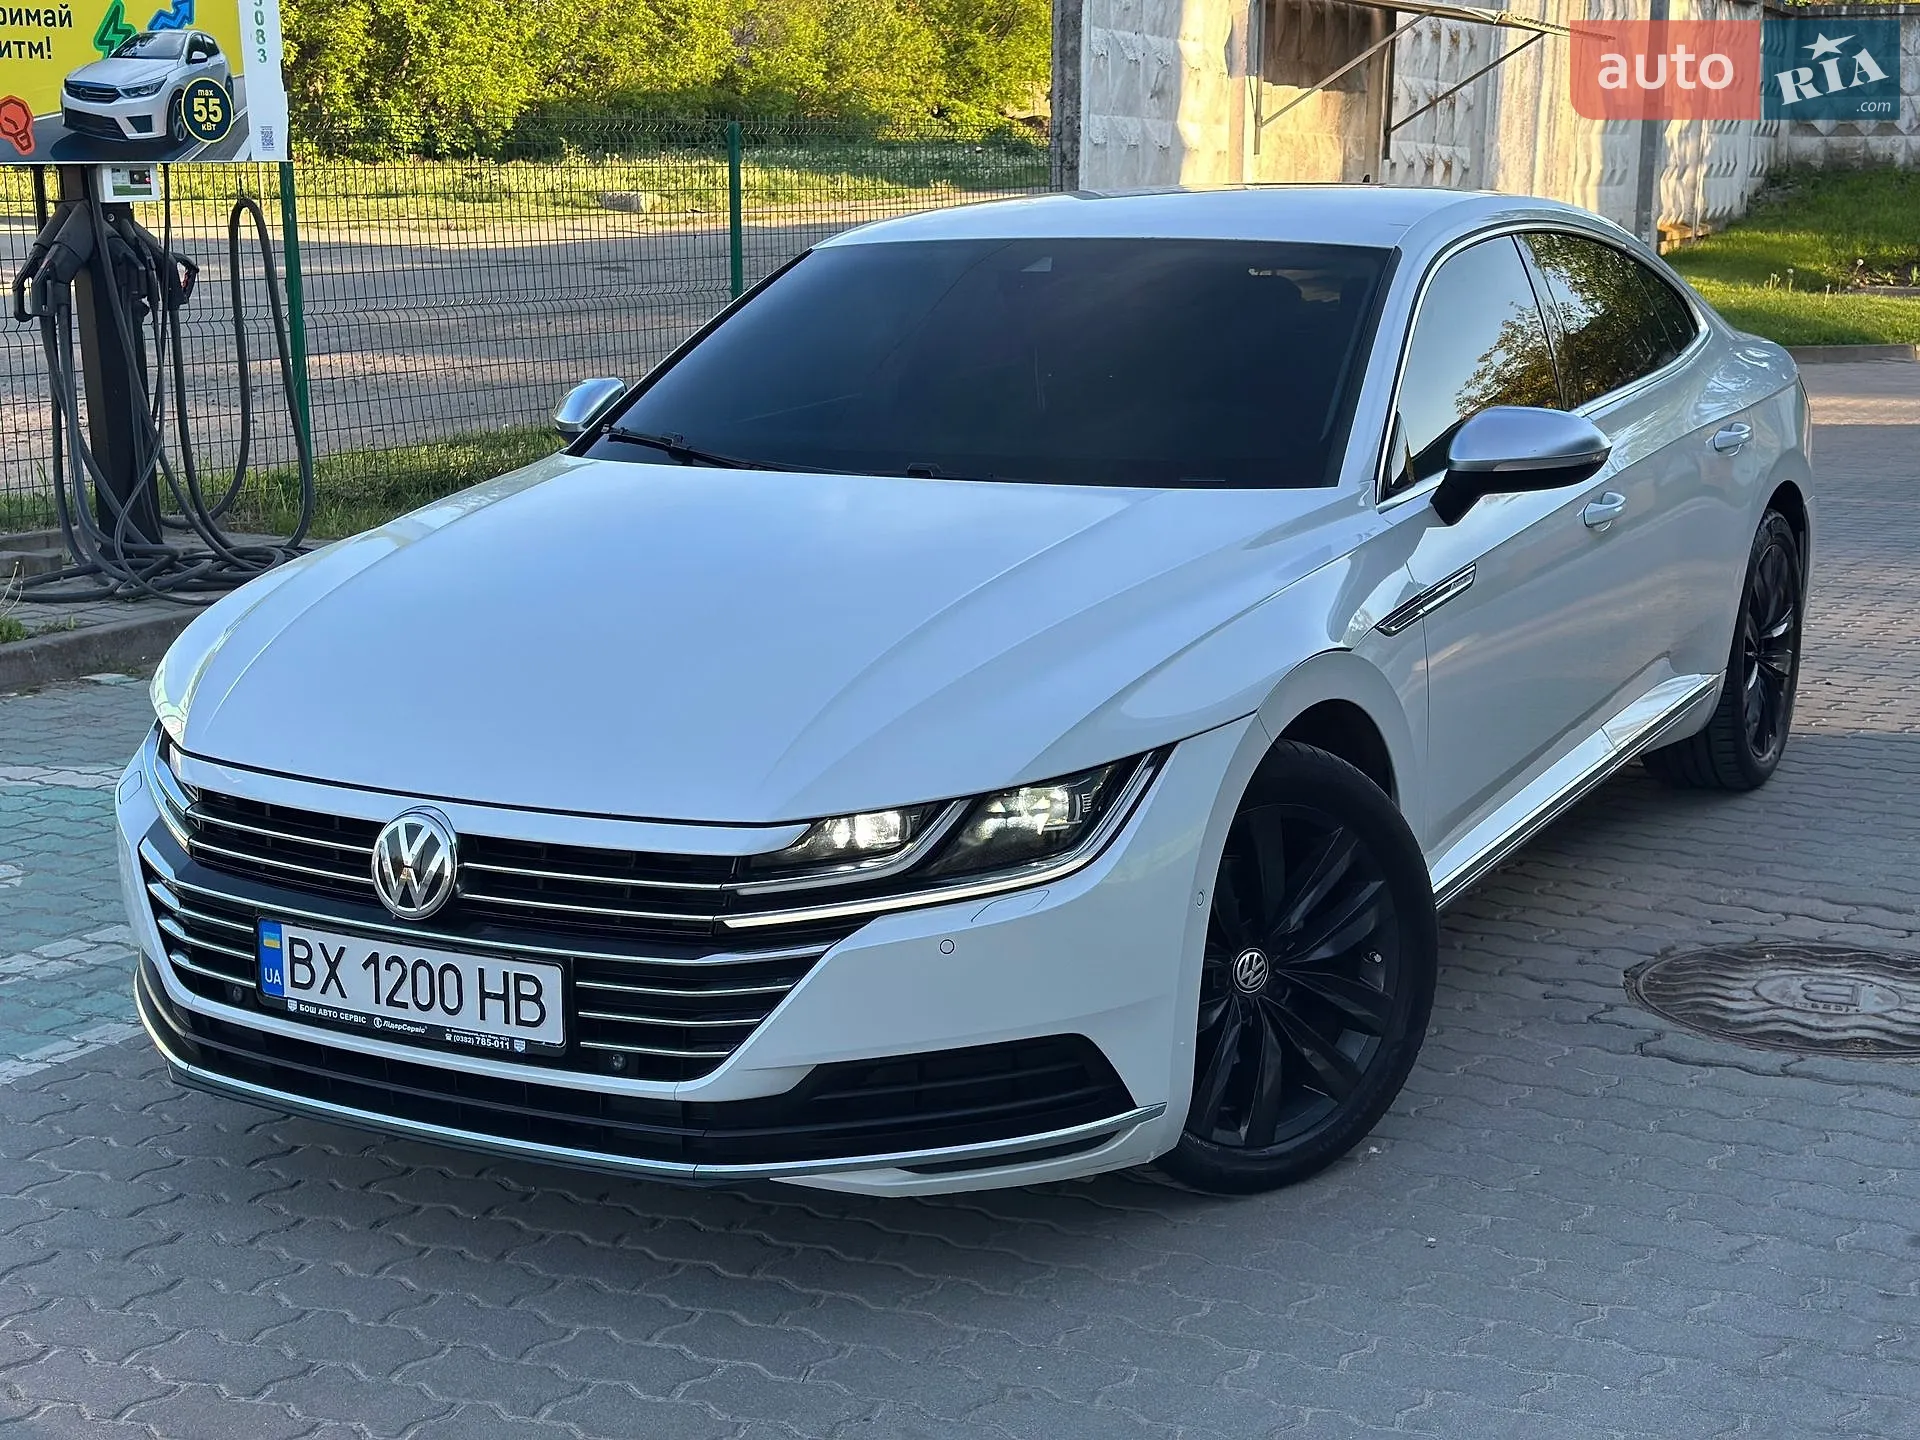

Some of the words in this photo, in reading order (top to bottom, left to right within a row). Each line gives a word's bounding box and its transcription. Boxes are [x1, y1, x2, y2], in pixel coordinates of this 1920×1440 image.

[193, 98, 223, 123] 55
[201, 123, 217, 131] кВт
[264, 967, 282, 986] UA
[288, 936, 348, 999] BX
[361, 951, 464, 1016] 1200
[478, 967, 547, 1028] HB
[299, 1003, 317, 1015] БОШ
[318, 1007, 338, 1018] АВТО
[339, 1011, 367, 1024] СЕРВІС
[475, 1037, 510, 1050] 785-011
